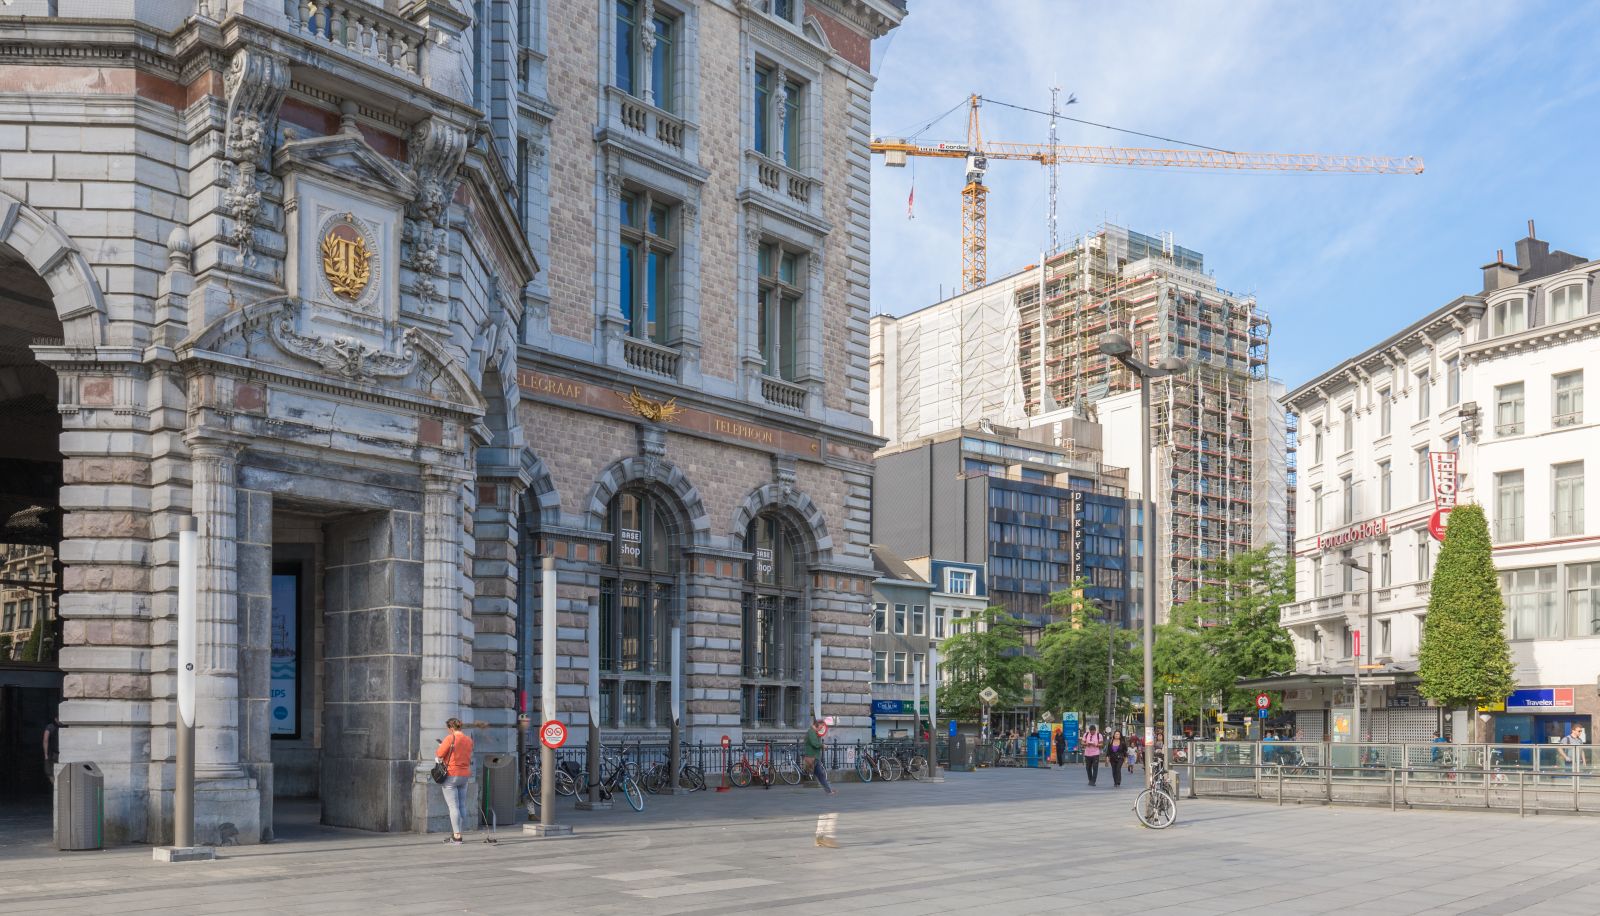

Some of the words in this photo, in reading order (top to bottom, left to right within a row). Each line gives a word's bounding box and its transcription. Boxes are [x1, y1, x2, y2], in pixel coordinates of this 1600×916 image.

[517, 373, 583, 399] LEGRAAF
[714, 419, 773, 443] TELEPHOON
[1437, 453, 1455, 507] HOTEL
[1075, 492, 1082, 511] DE
[621, 531, 639, 540] BASE
[1317, 528, 1359, 549] Leonardo
[1360, 517, 1387, 539] Hotel
[620, 543, 641, 559] shop
[271, 688, 286, 698] IPS
